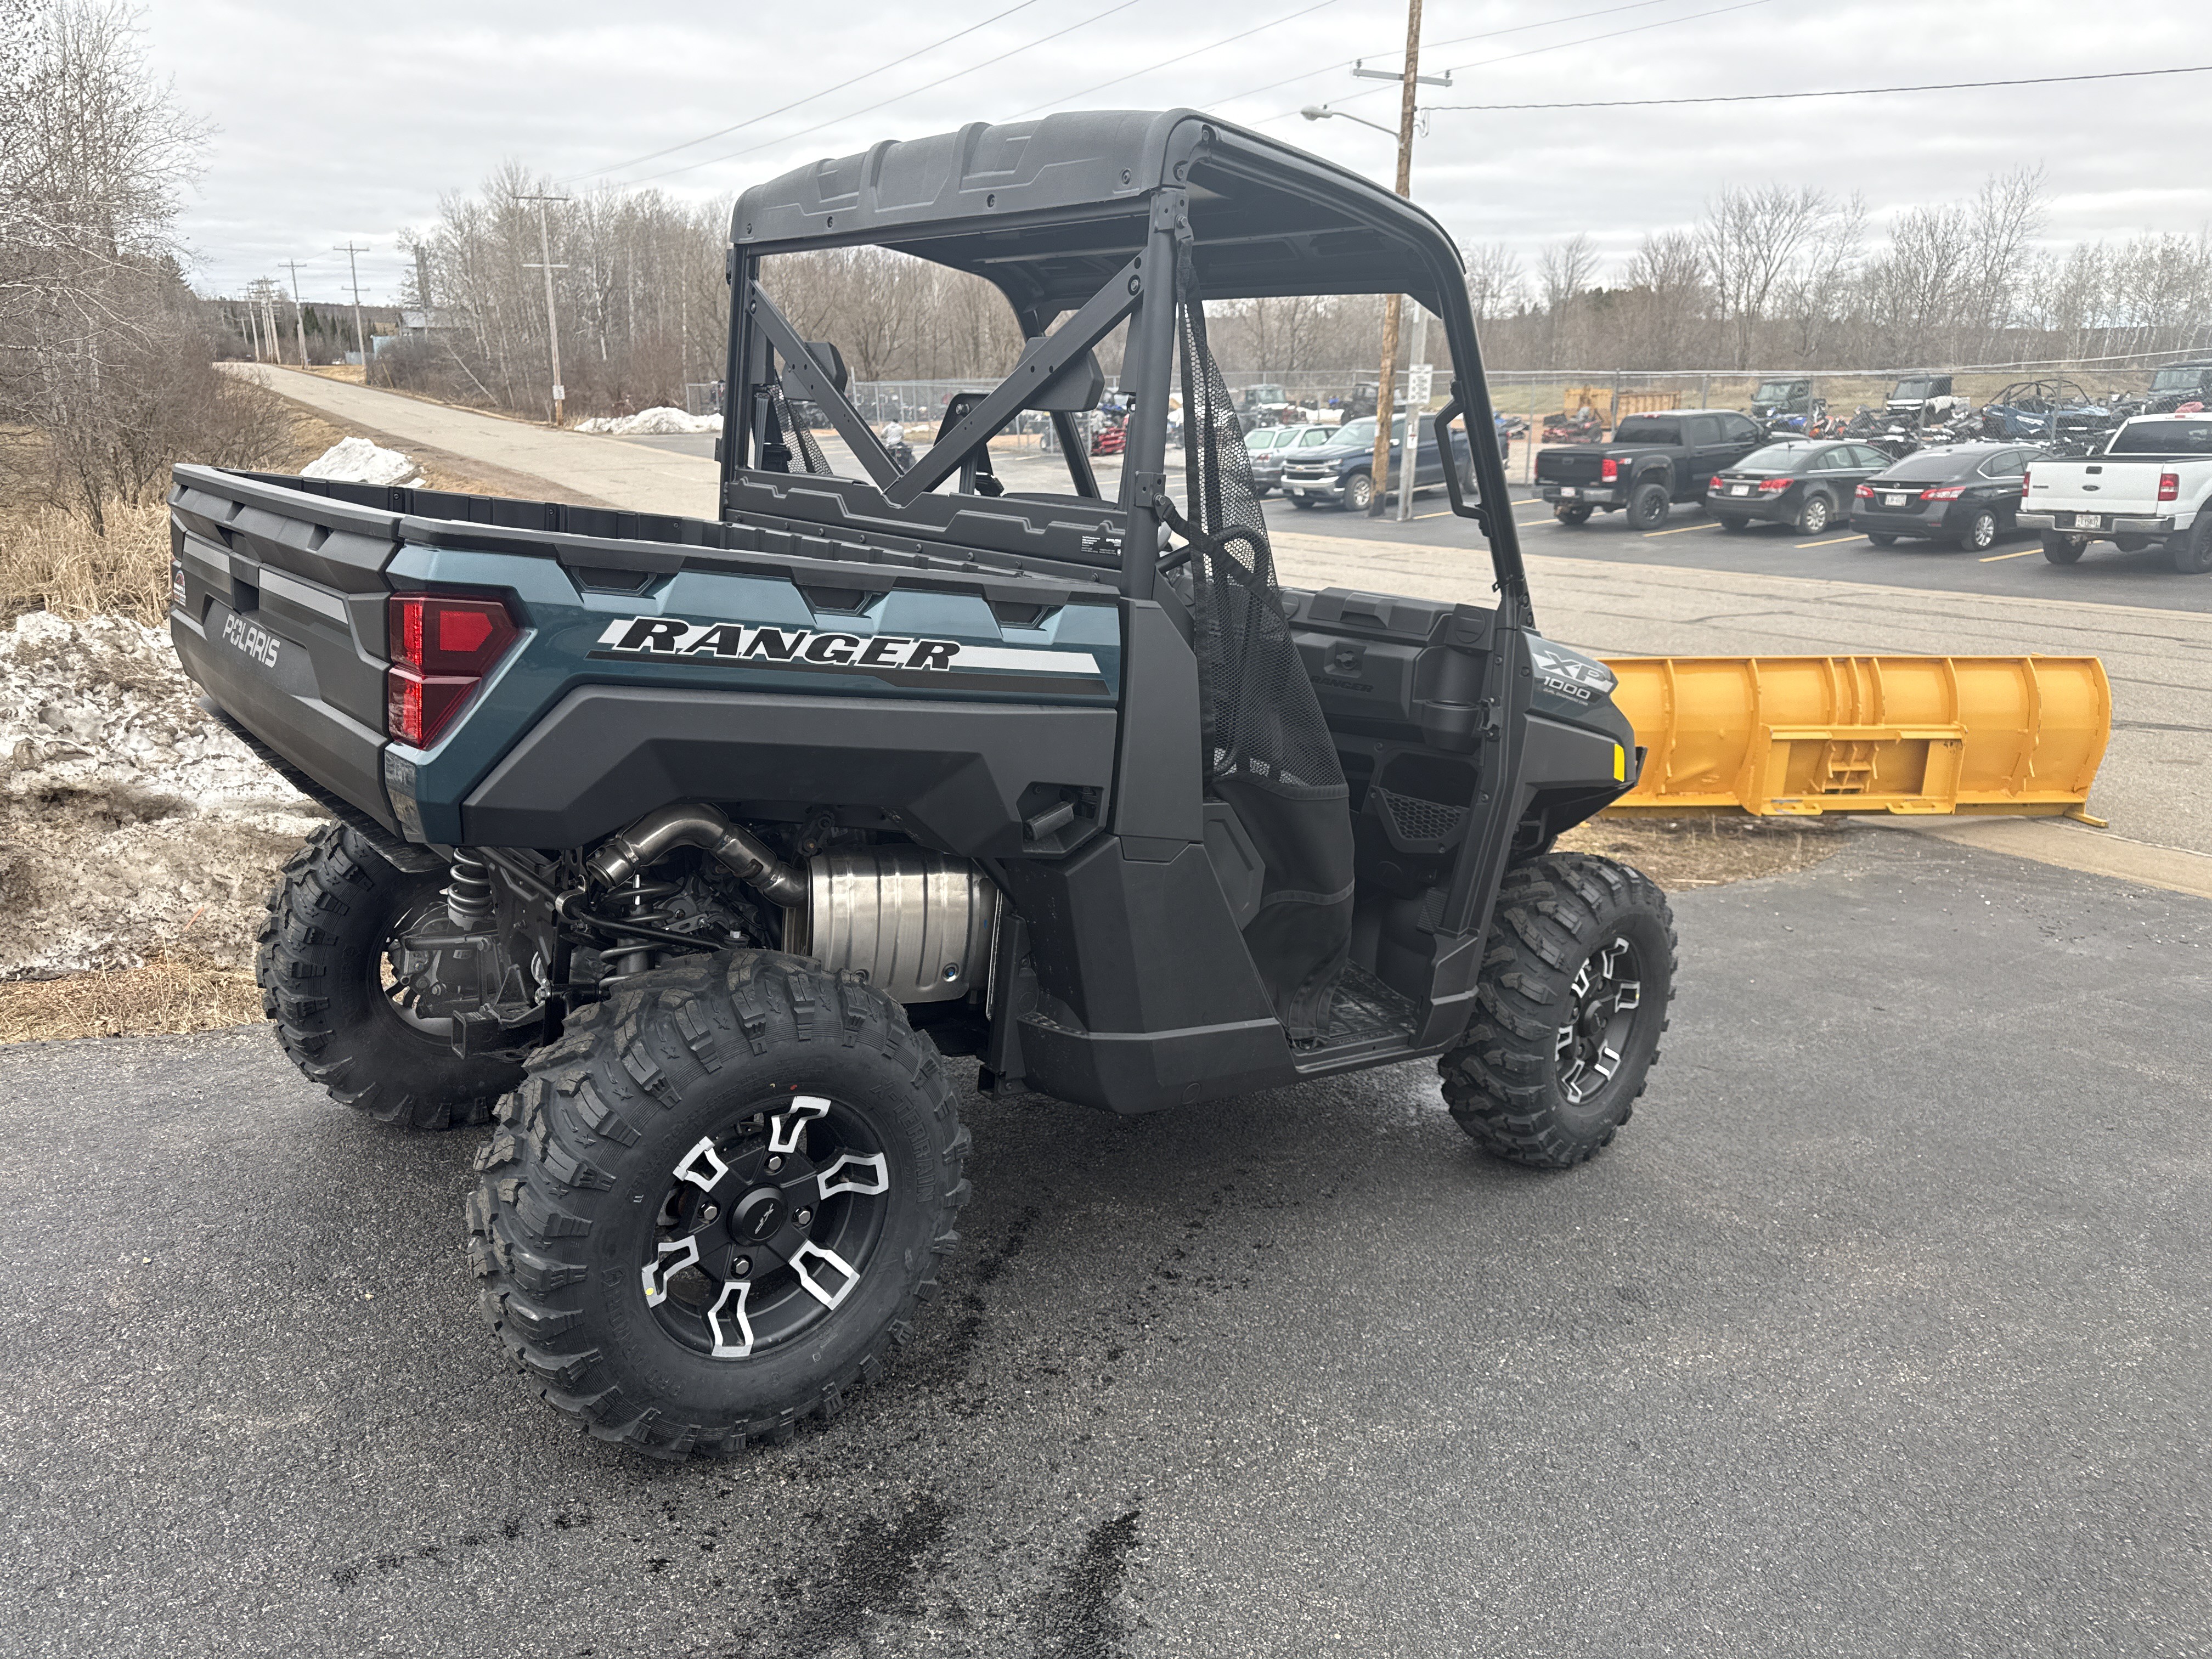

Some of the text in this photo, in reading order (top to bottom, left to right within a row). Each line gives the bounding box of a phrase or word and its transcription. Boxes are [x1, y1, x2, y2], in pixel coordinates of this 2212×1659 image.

[222, 613, 281, 668] POLARIS
[616, 616, 961, 671] RANGER
[1310, 675, 1374, 693] RANGER
[1539, 650, 1607, 682] XP
[1544, 676, 1590, 699] 1000
[869, 1074, 936, 1204] X-TERRAIN
